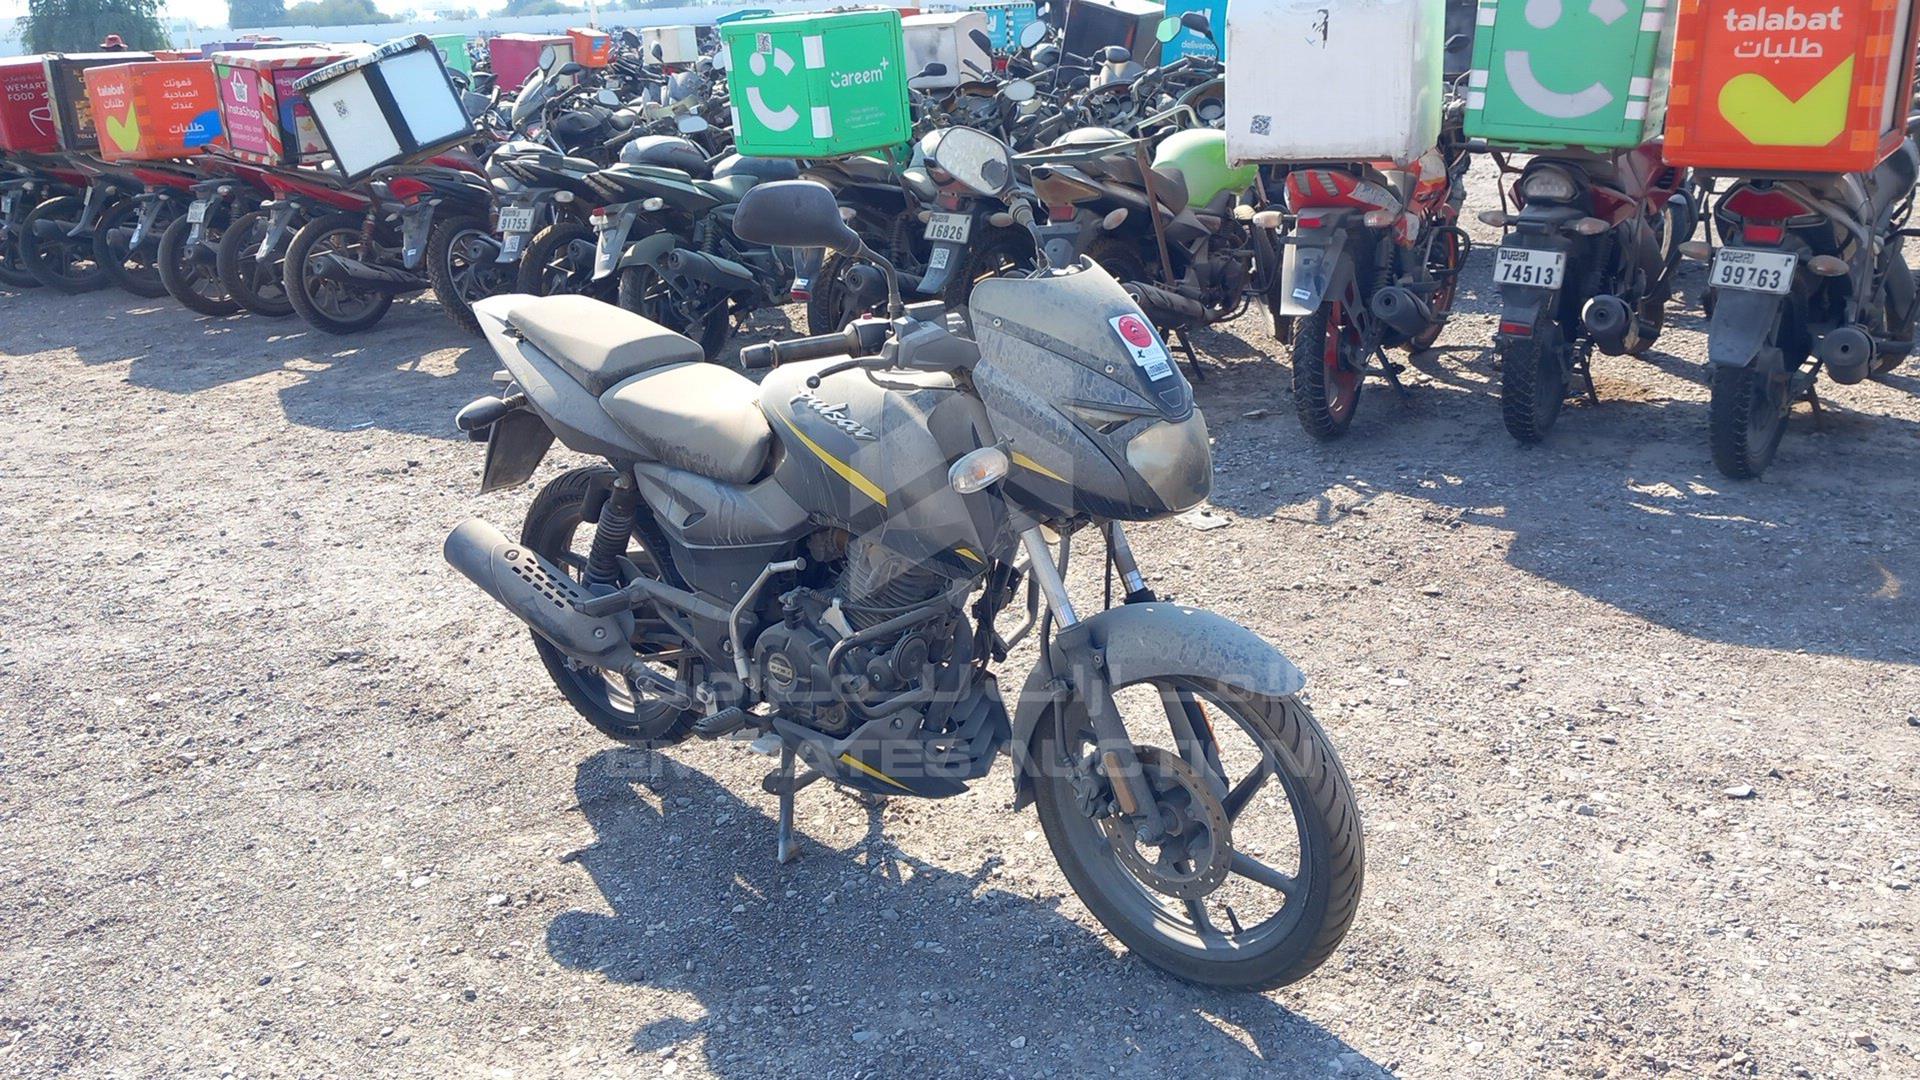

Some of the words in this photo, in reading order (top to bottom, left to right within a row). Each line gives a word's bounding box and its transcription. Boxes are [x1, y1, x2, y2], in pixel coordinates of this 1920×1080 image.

[1723, 6, 1843, 31] talabat
[1734, 37, 1823, 64] طلبات
[8, 92, 35, 102] FOOD
[97, 84, 125, 96] talabat
[103, 98, 125, 109] طلبات
[168, 122, 205, 136] طلبات
[501, 218, 528, 230] 91755
[930, 224, 963, 240] 16826
[1503, 264, 1553, 285] 74513
[1721, 265, 1781, 289] 99763
